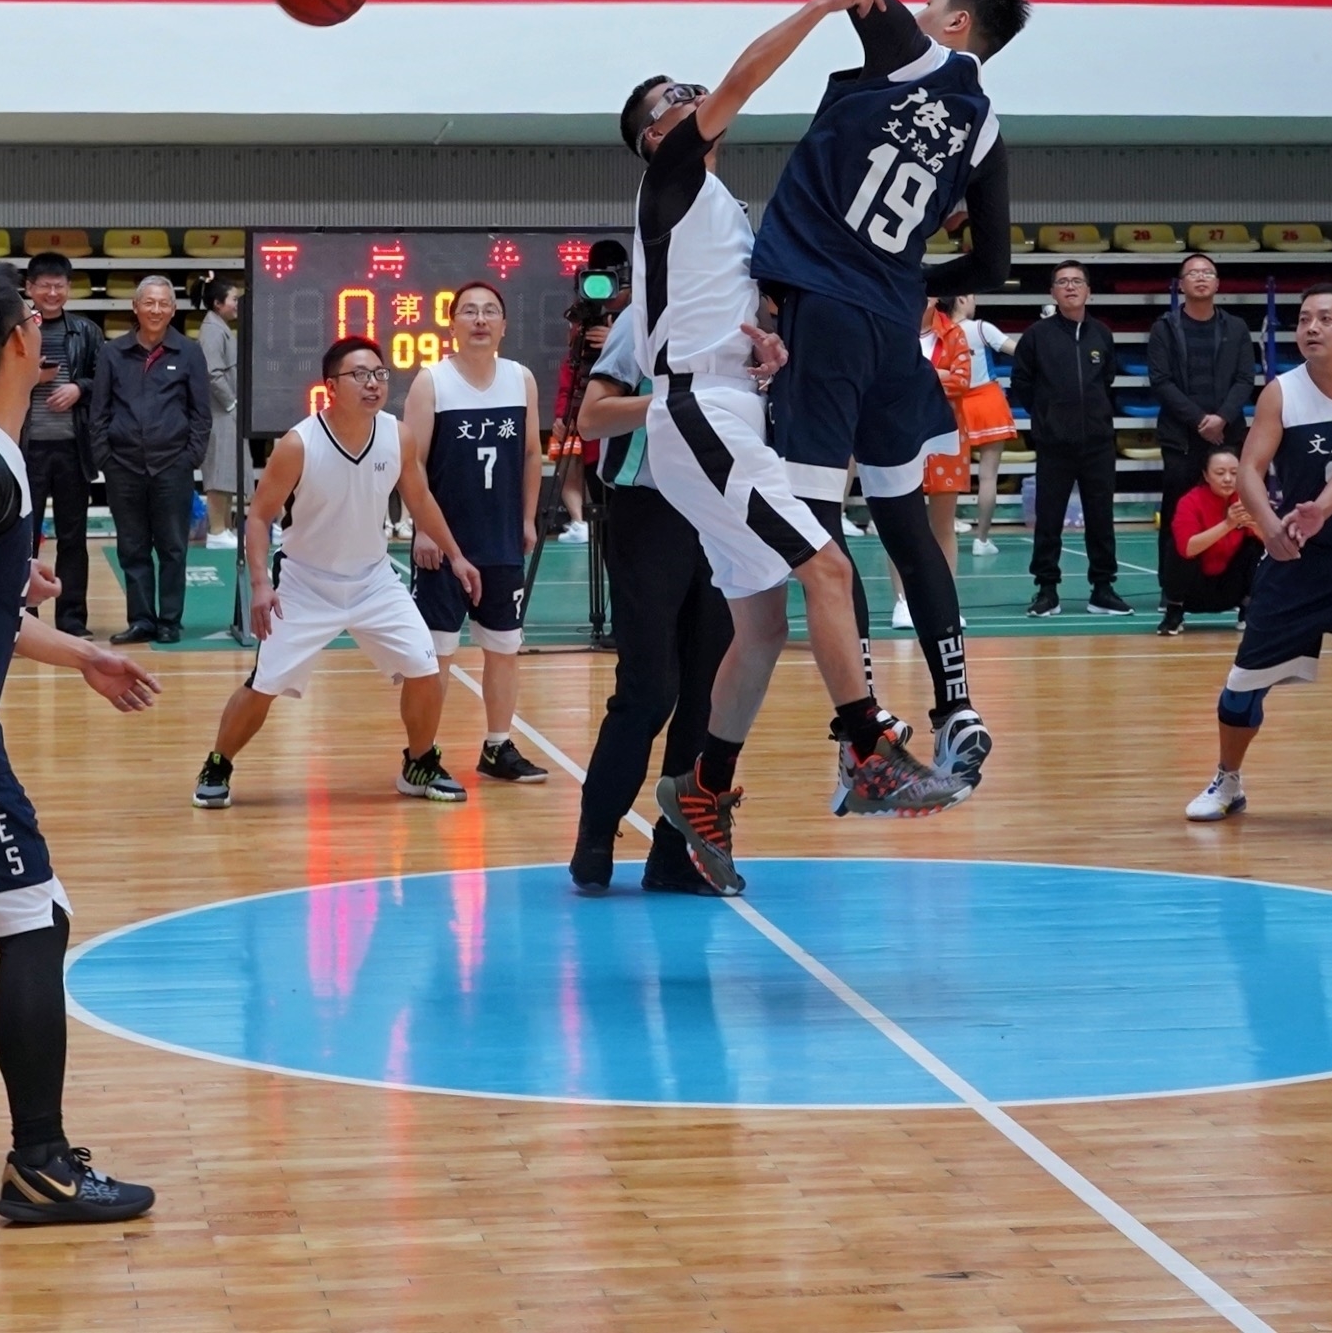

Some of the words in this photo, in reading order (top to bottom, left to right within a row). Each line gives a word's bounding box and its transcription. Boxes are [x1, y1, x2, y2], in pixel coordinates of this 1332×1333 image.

[890, 86, 972, 157] 广安市
[844, 142, 938, 255] 19
[130, 235, 141, 246] 8
[210, 235, 219, 246] 7
[1209, 229, 1224, 241] 27
[392, 293, 423, 326] 第
[456, 418, 518, 441] 文广旅
[476, 446, 498, 490] 7
[512, 587, 525, 620] 7
